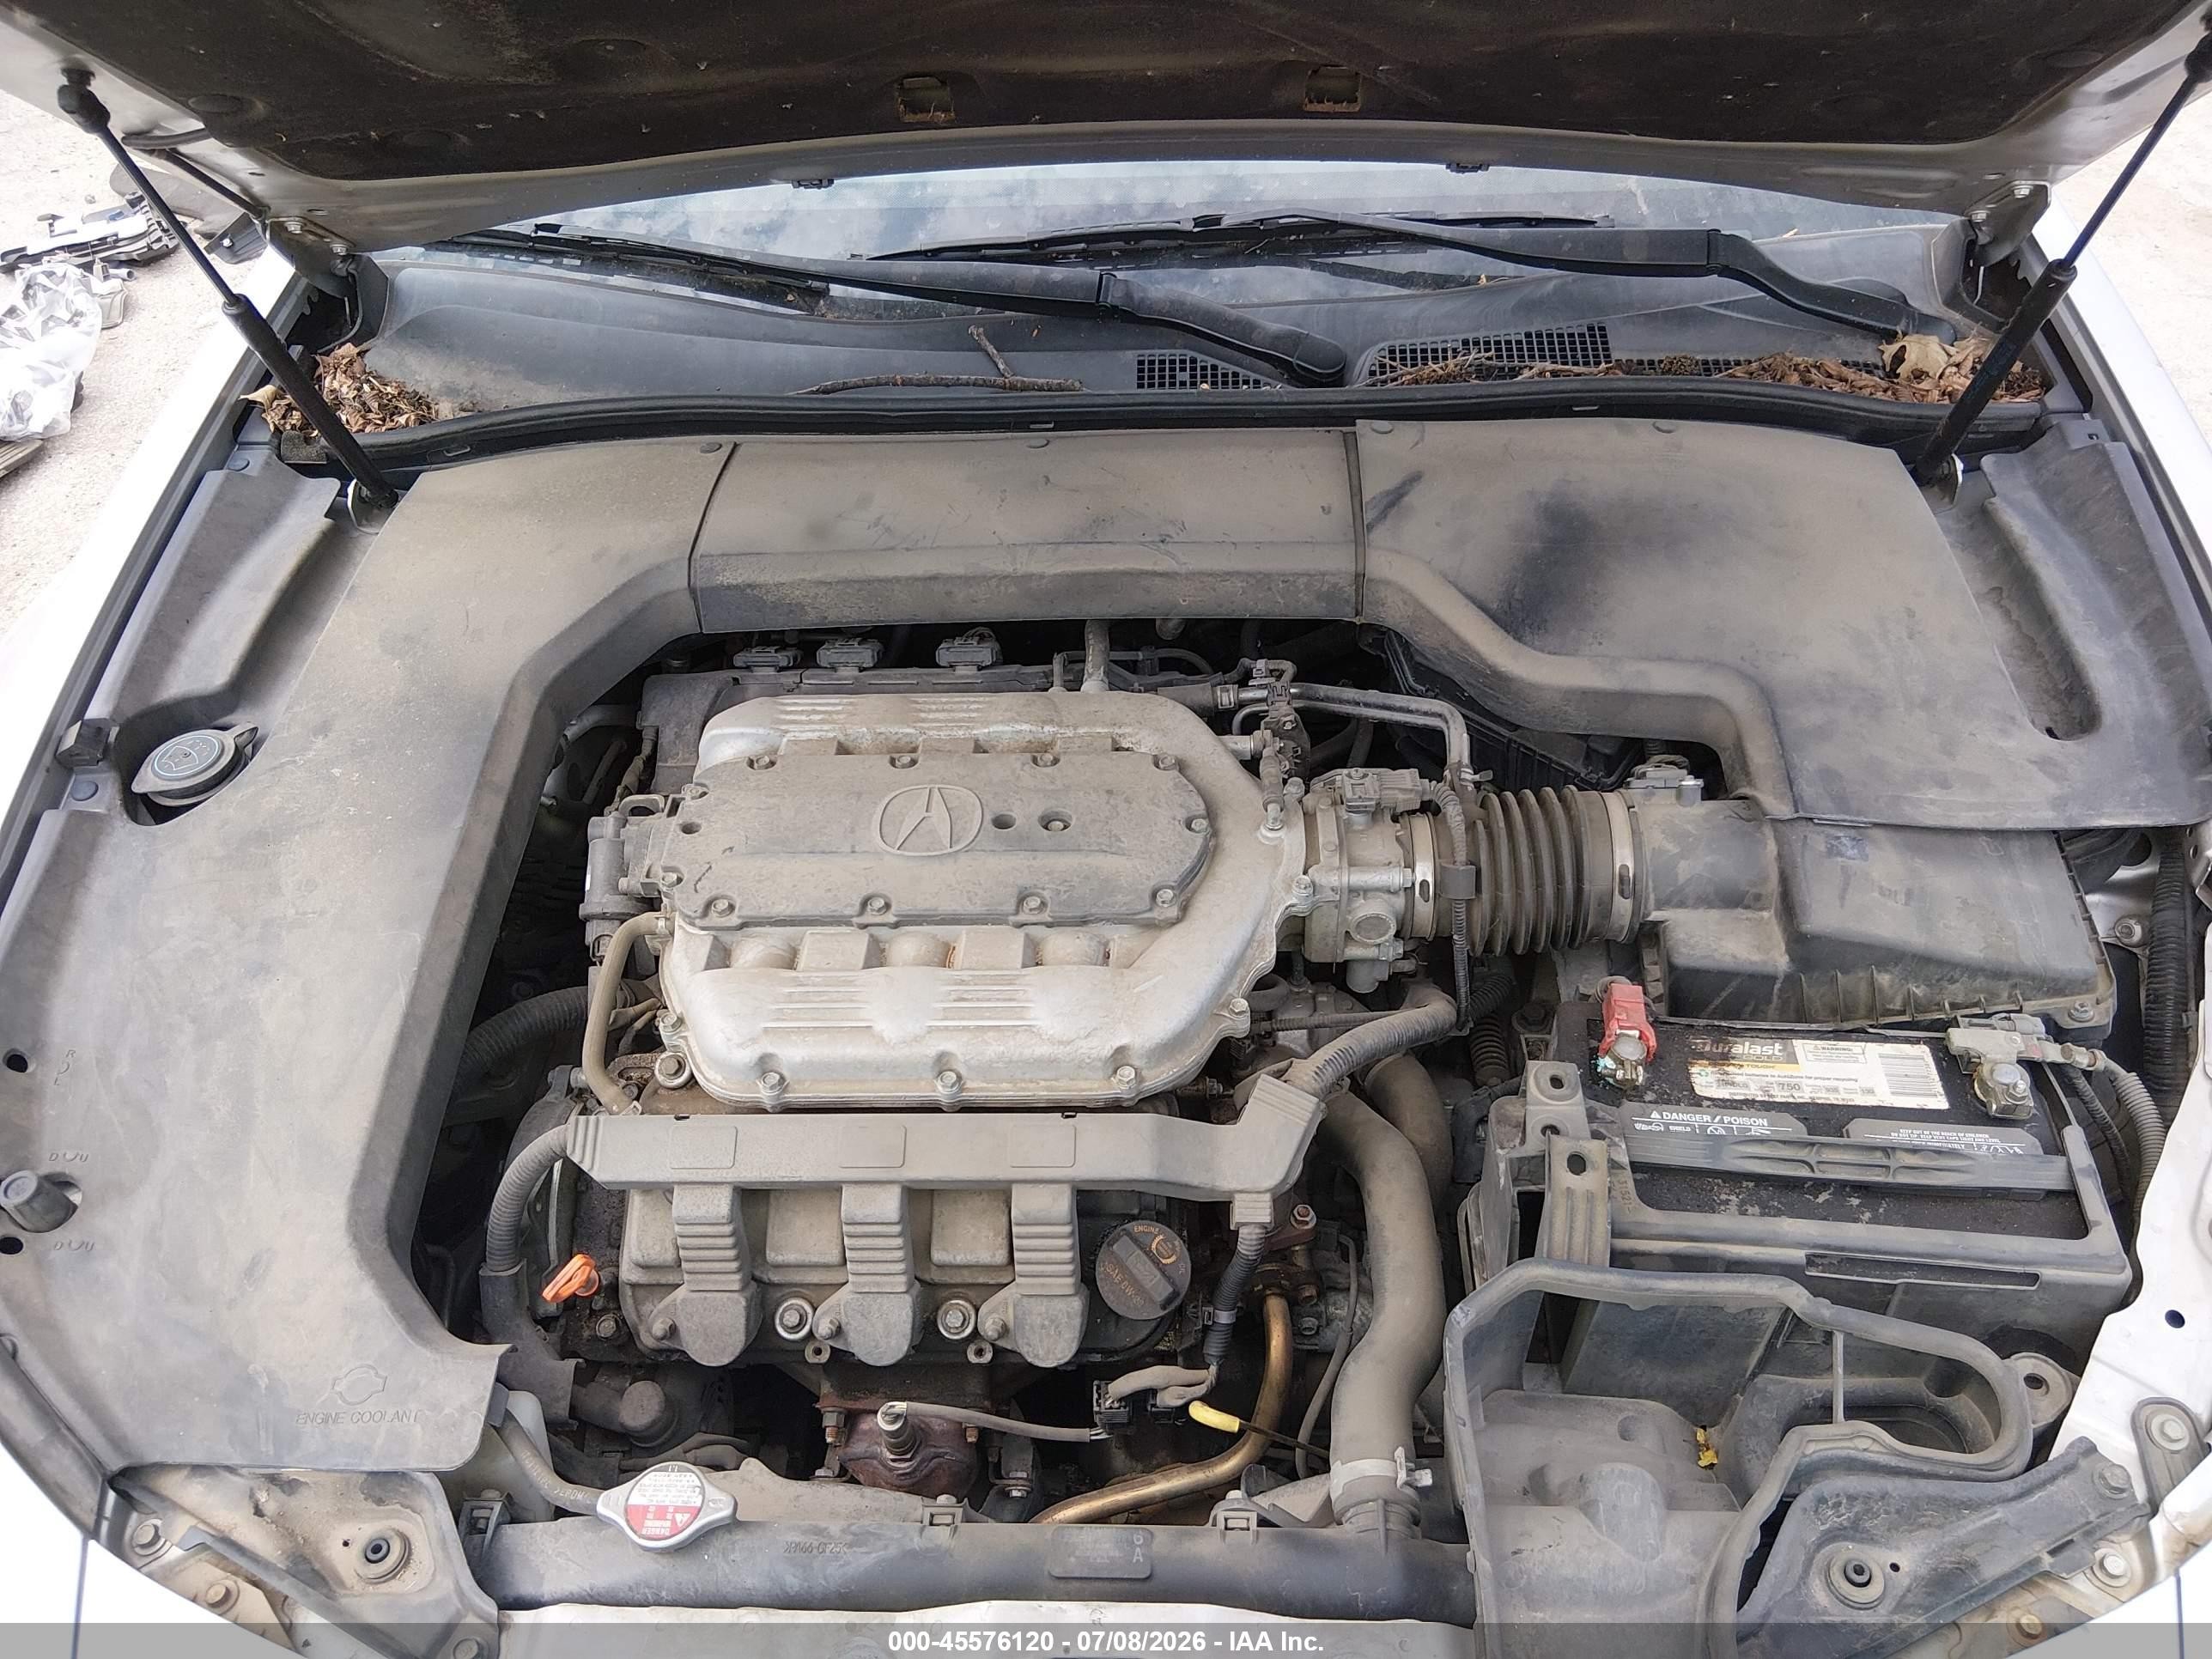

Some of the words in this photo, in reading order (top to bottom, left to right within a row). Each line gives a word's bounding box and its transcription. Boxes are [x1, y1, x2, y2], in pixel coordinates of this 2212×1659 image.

[1779, 1082, 1801, 1091] 750
[1662, 1111, 1711, 1122] DANGER
[1723, 1115, 1768, 1126] POISON
[1133, 1225, 1159, 1235] ENGINE
[1106, 1263, 1124, 1283] SAE
[295, 1411, 347, 1425] ENGINE
[350, 1408, 422, 1425] COOLANT
[668, 1464, 678, 1473] 1.1
[641, 1527, 672, 1536] DANGER
[1133, 1547, 1144, 1563] A
